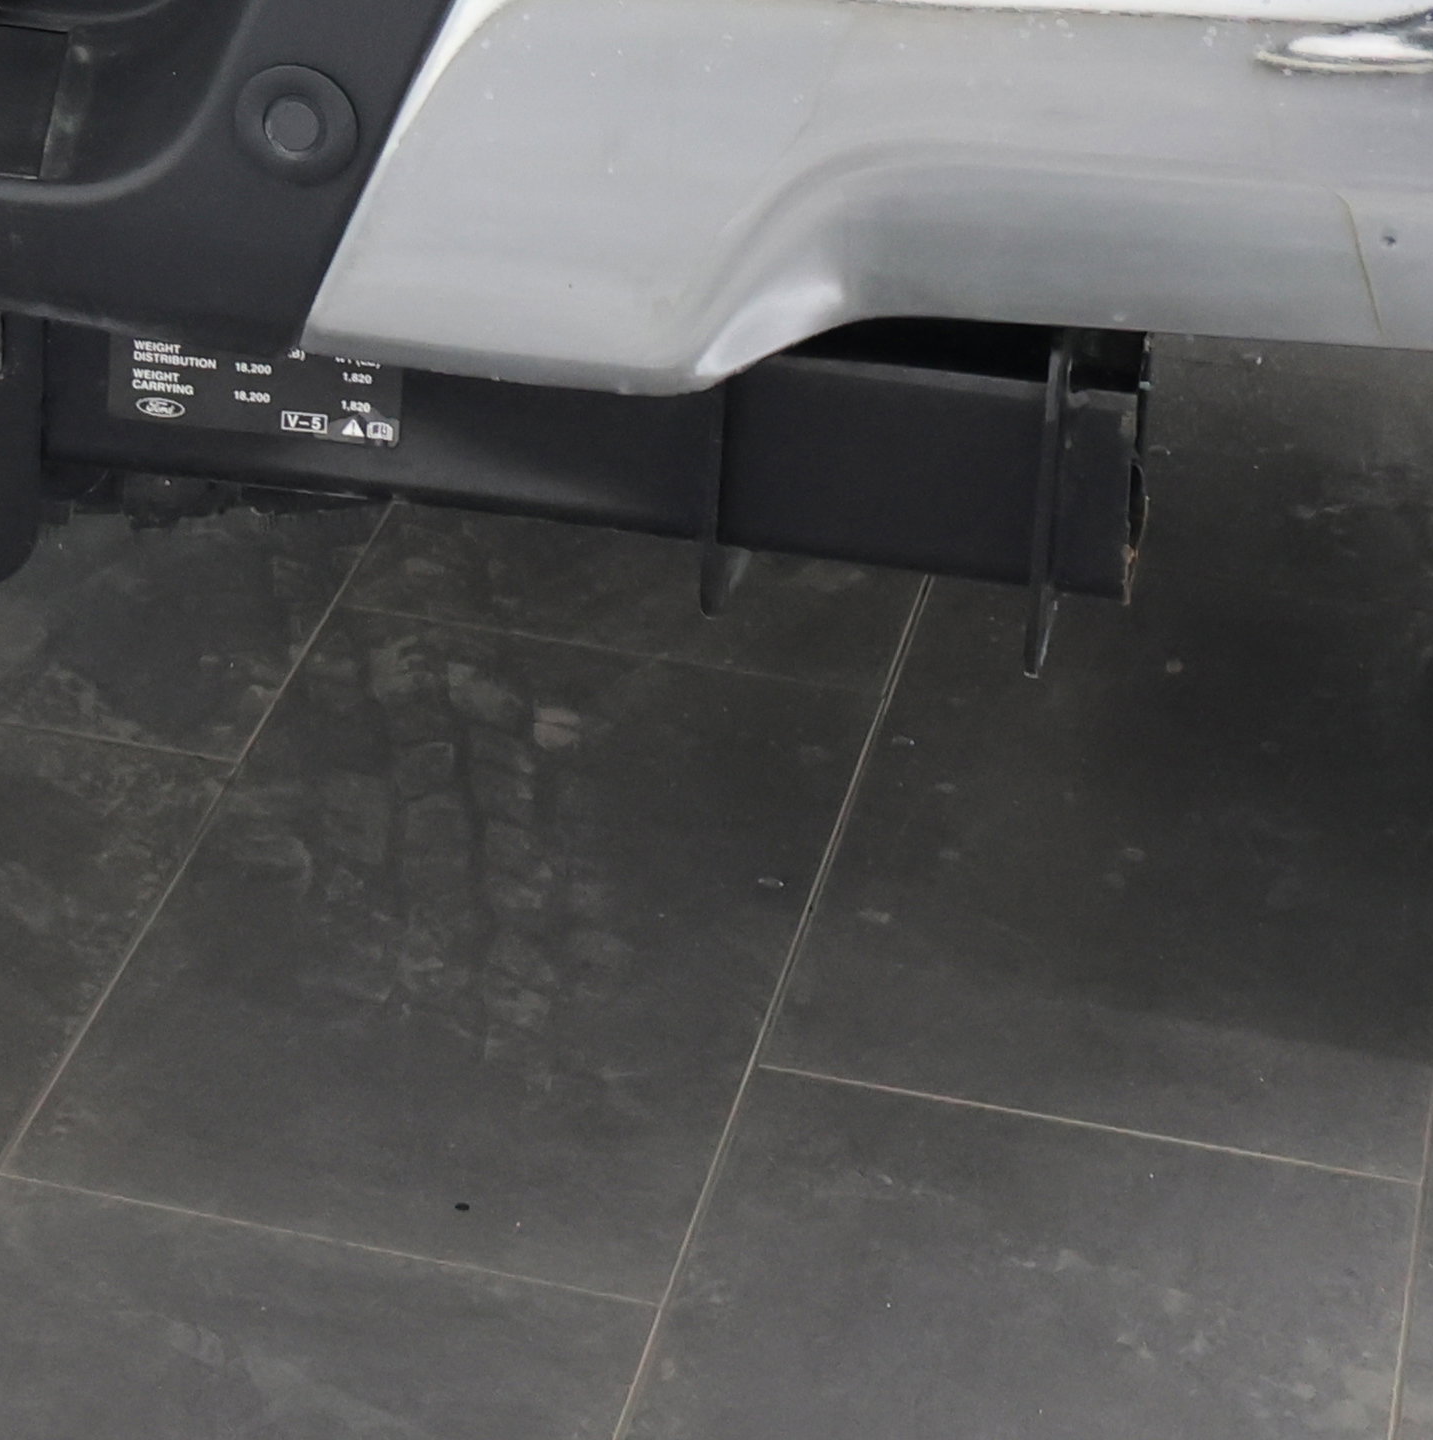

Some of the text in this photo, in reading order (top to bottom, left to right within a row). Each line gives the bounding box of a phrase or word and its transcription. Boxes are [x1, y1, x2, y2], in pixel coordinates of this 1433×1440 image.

[133, 339, 181, 355] WEIGHT
[133, 351, 217, 370] DISTRIBUTION
[132, 368, 180, 383] WEIGHT
[132, 378, 195, 396] CARRYING
